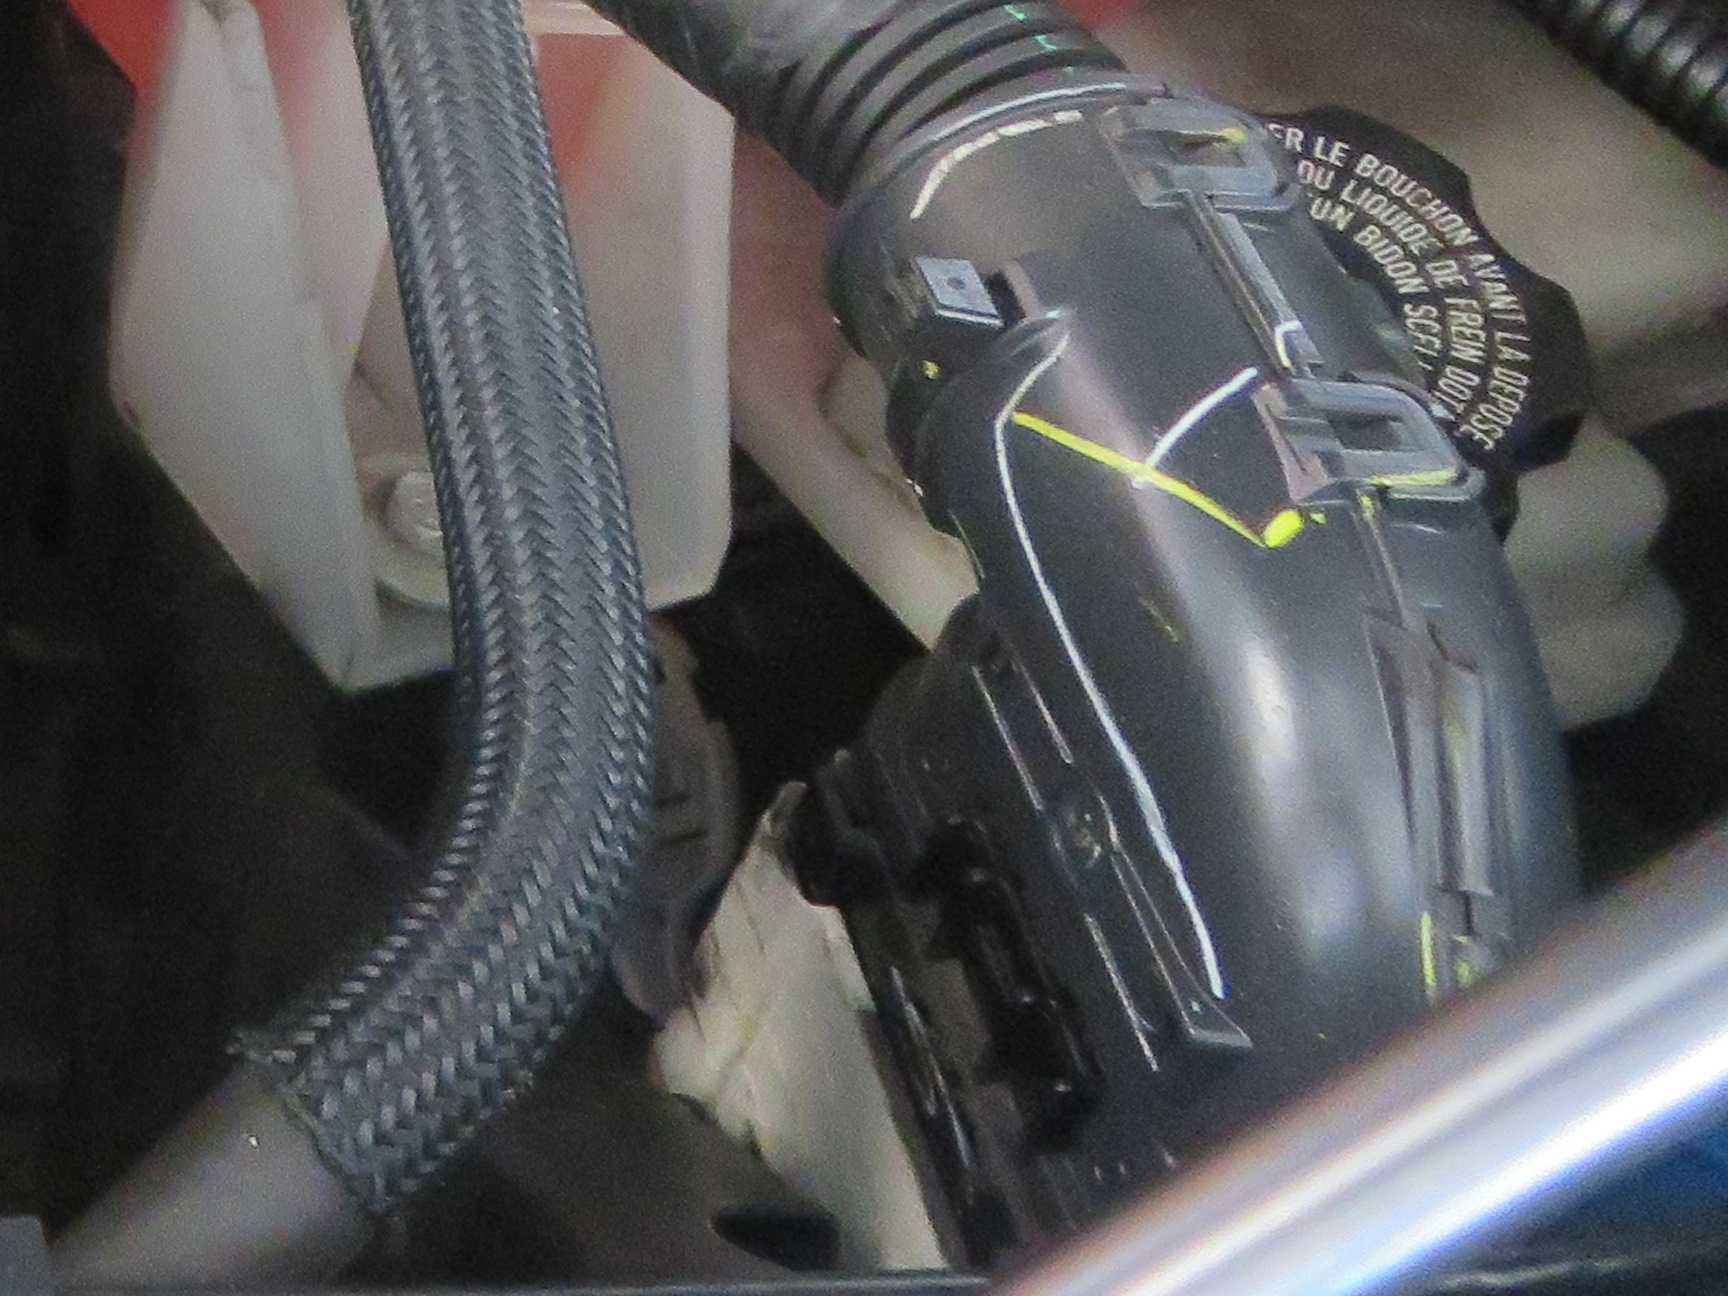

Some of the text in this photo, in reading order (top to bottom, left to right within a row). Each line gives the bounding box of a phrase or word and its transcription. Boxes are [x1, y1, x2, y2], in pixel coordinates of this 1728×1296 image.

[1313, 135, 1350, 168] LE
[1340, 179, 1445, 257] LIQUIDE
[1354, 153, 1481, 247] BOUCHON
[1353, 224, 1430, 295] BIDON
[1467, 253, 1528, 326] AVANT
[1443, 296, 1488, 365] FREIN
[1494, 331, 1532, 362] LA
[1431, 364, 1481, 414] DOT
